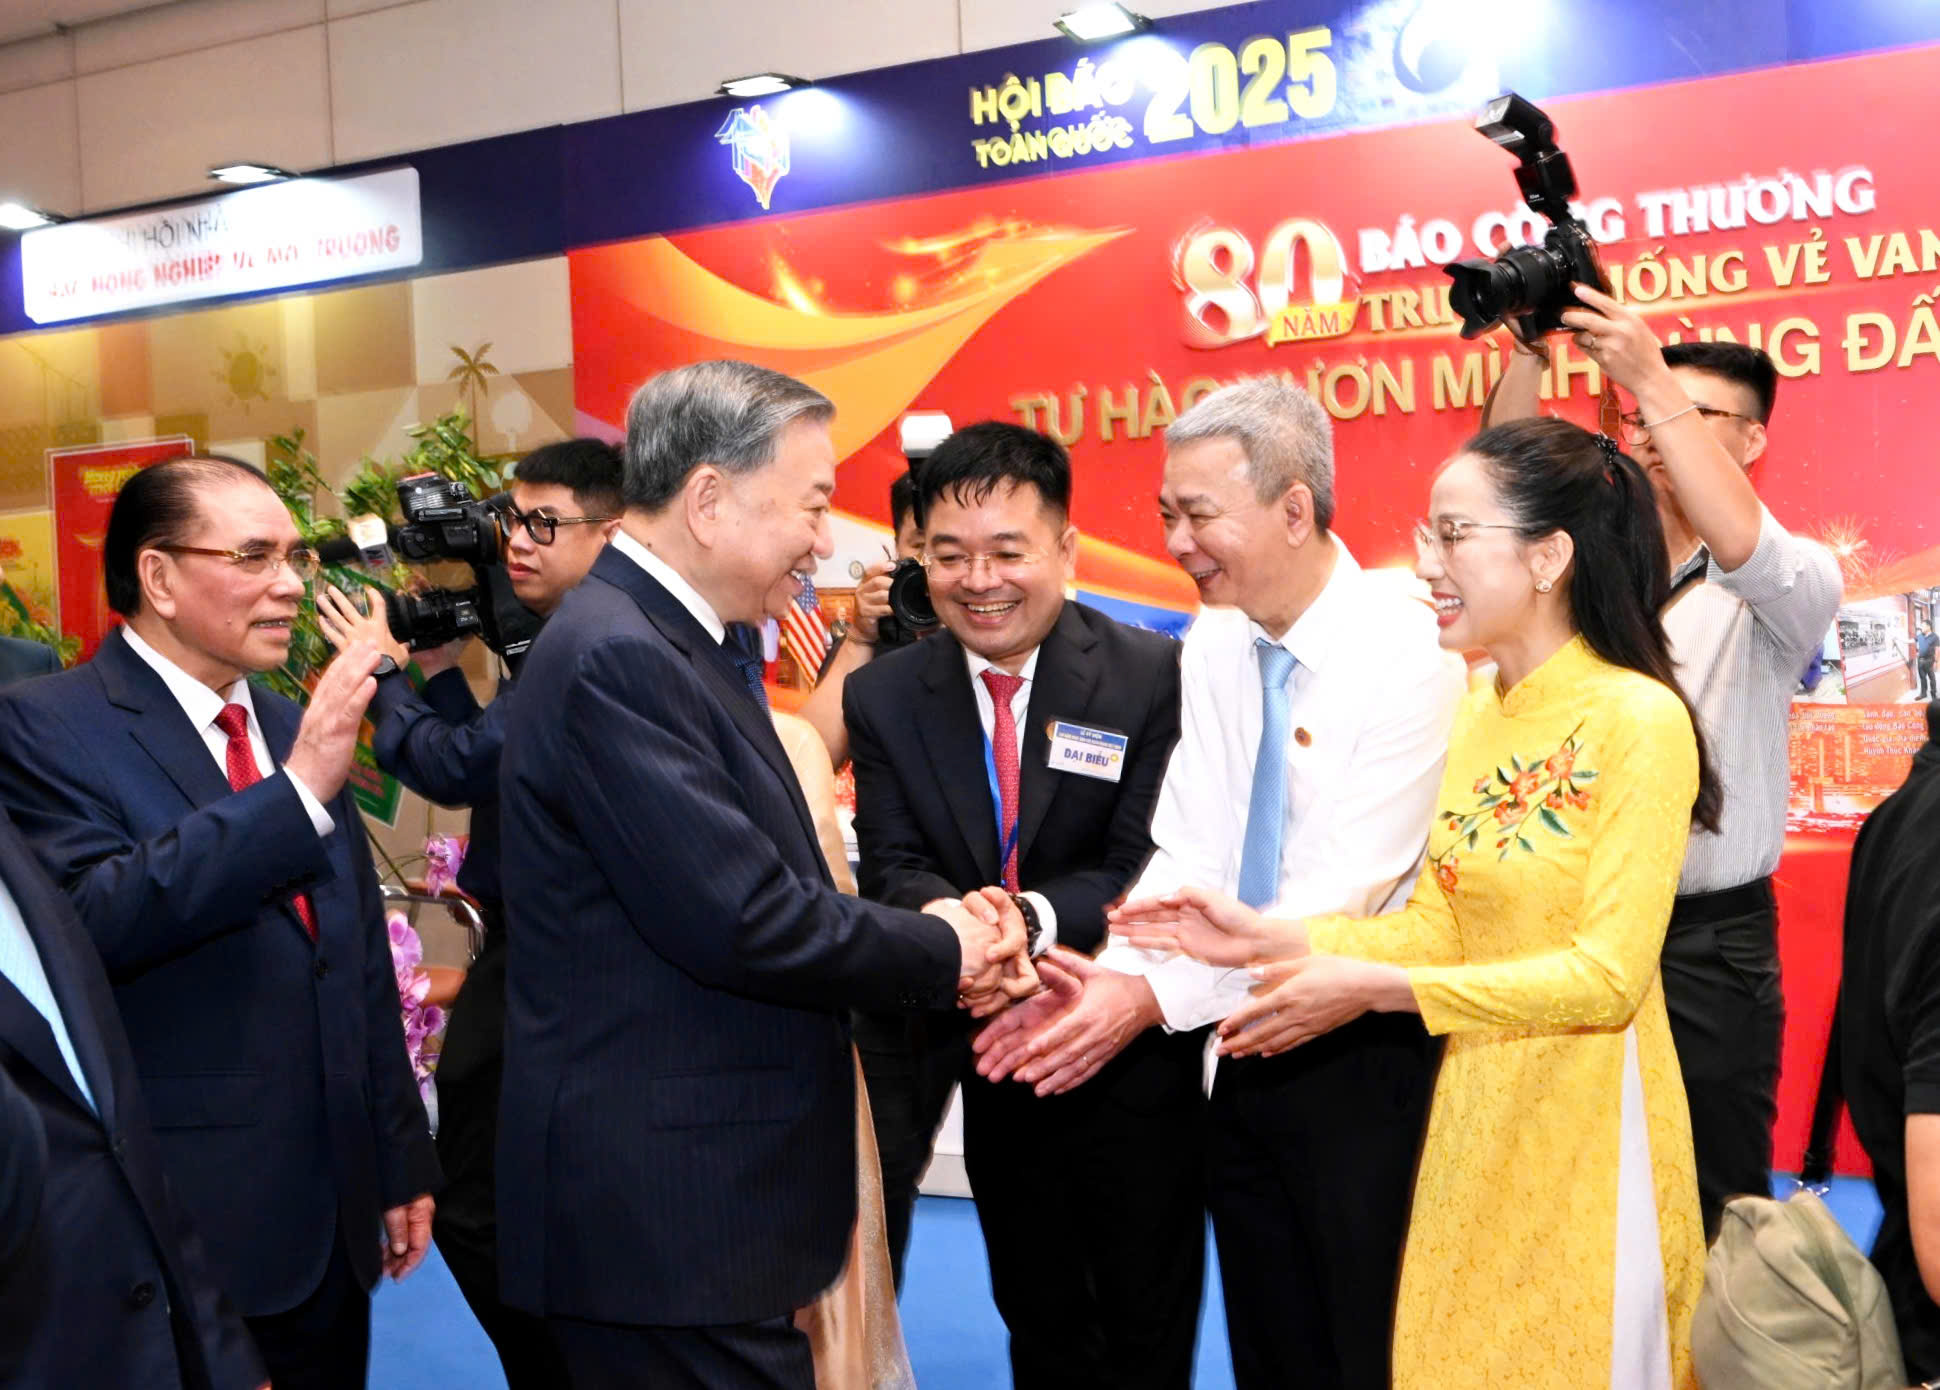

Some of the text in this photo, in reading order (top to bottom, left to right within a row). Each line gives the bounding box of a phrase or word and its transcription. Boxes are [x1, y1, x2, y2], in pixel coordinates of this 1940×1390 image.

[970, 74, 1042, 133] HỘI
[1143, 27, 1337, 144] 2025
[1360, 168, 1876, 273] BÁO CÔG THƯƠNG
[1184, 217, 1348, 343] 80
[1609, 245, 1749, 305] ỐNG
[1763, 227, 1832, 288] VẺ
[1283, 308, 1340, 338] NĂM
[1281, 354, 1416, 420] ƠN
[1432, 336, 1601, 411] MÌH
